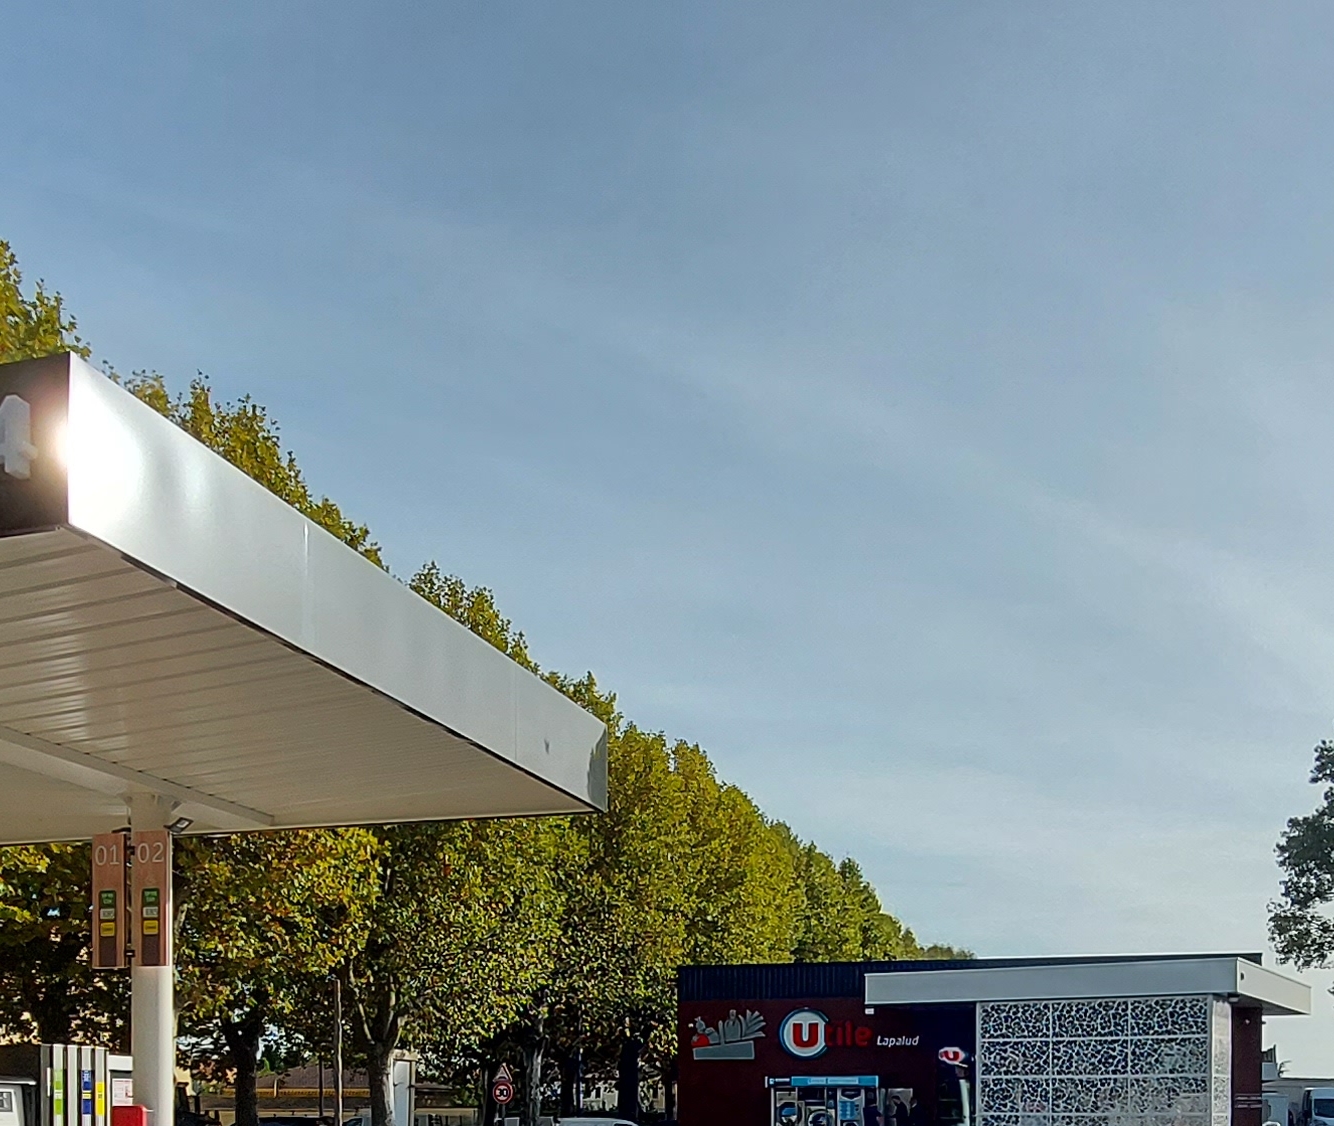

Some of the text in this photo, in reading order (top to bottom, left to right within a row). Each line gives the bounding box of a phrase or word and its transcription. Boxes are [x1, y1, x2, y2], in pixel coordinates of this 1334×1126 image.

[94, 844, 120, 866] 01
[137, 842, 165, 864] 02
[876, 1034, 920, 1048] Lapalud
[943, 1050, 960, 1062] U
